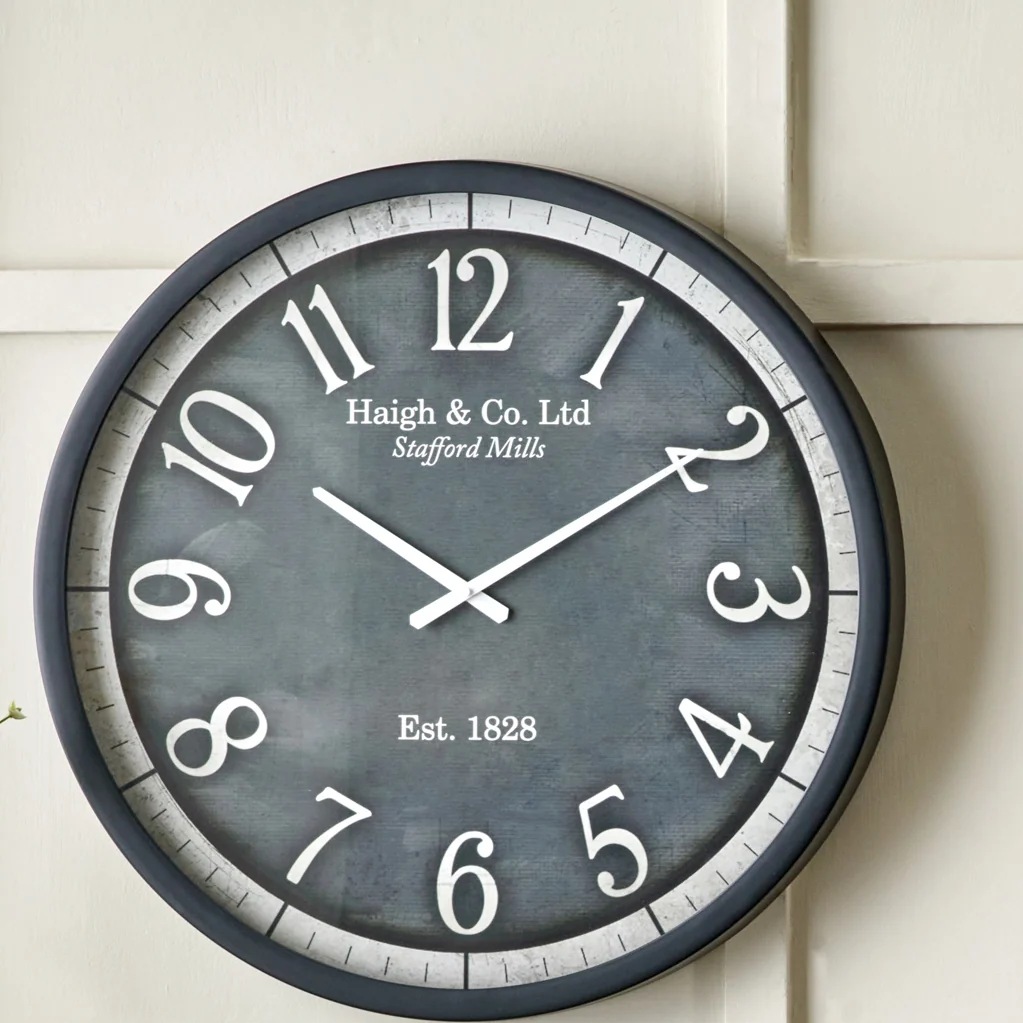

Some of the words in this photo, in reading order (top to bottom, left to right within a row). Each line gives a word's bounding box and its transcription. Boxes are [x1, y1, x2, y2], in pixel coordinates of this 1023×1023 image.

[280, 283, 376, 396] 11
[427, 247, 514, 352] 12
[579, 296, 645, 390] 1
[160, 388, 276, 508] 10
[346, 398, 437, 431] Haigh
[446, 398, 472, 426] &
[481, 398, 529, 426] Co.
[538, 399, 592, 426] Ltd
[392, 435, 483, 467] Stafford
[485, 435, 547, 459] Mills
[664, 405, 770, 493] 2
[127, 558, 232, 621] 9
[706, 561, 811, 623] 3
[166, 696, 268, 777] 8
[397, 714, 457, 742] Est.
[467, 714, 538, 742] 1828
[678, 697, 775, 779] 4
[286, 786, 373, 885] 7
[578, 783, 649, 898] 5
[436, 830, 499, 935] 6
